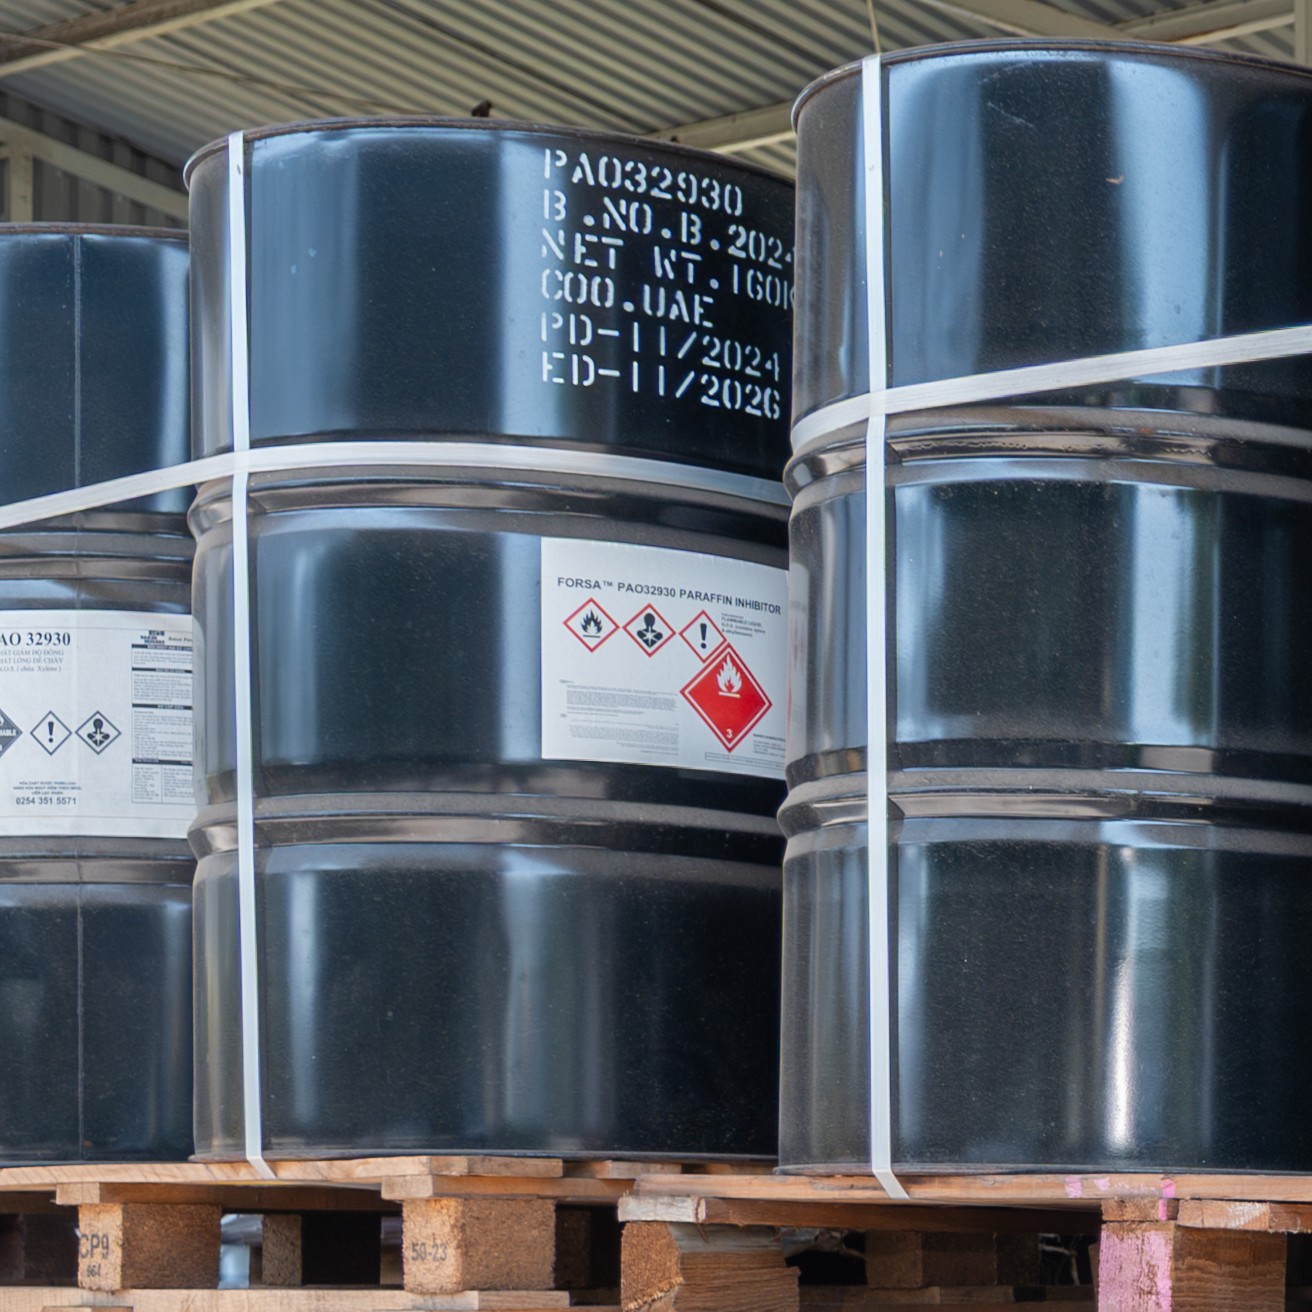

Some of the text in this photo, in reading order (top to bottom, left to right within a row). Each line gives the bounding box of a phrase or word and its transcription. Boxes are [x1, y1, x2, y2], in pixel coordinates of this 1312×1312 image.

[542, 228, 623, 269] NET
[541, 269, 713, 327] COO.UAE
[541, 312, 779, 381] PD-11/2024
[542, 351, 780, 420] ED-11/2026
[617, 582, 676, 598] PAO32930
[679, 589, 732, 606] PARAFFIN
[735, 597, 782, 615] INHIBITOR
[0, 631, 71, 646] AO 32930
[726, 729, 733, 740] 3
[16, 797, 77, 805] 0254 351 5571
